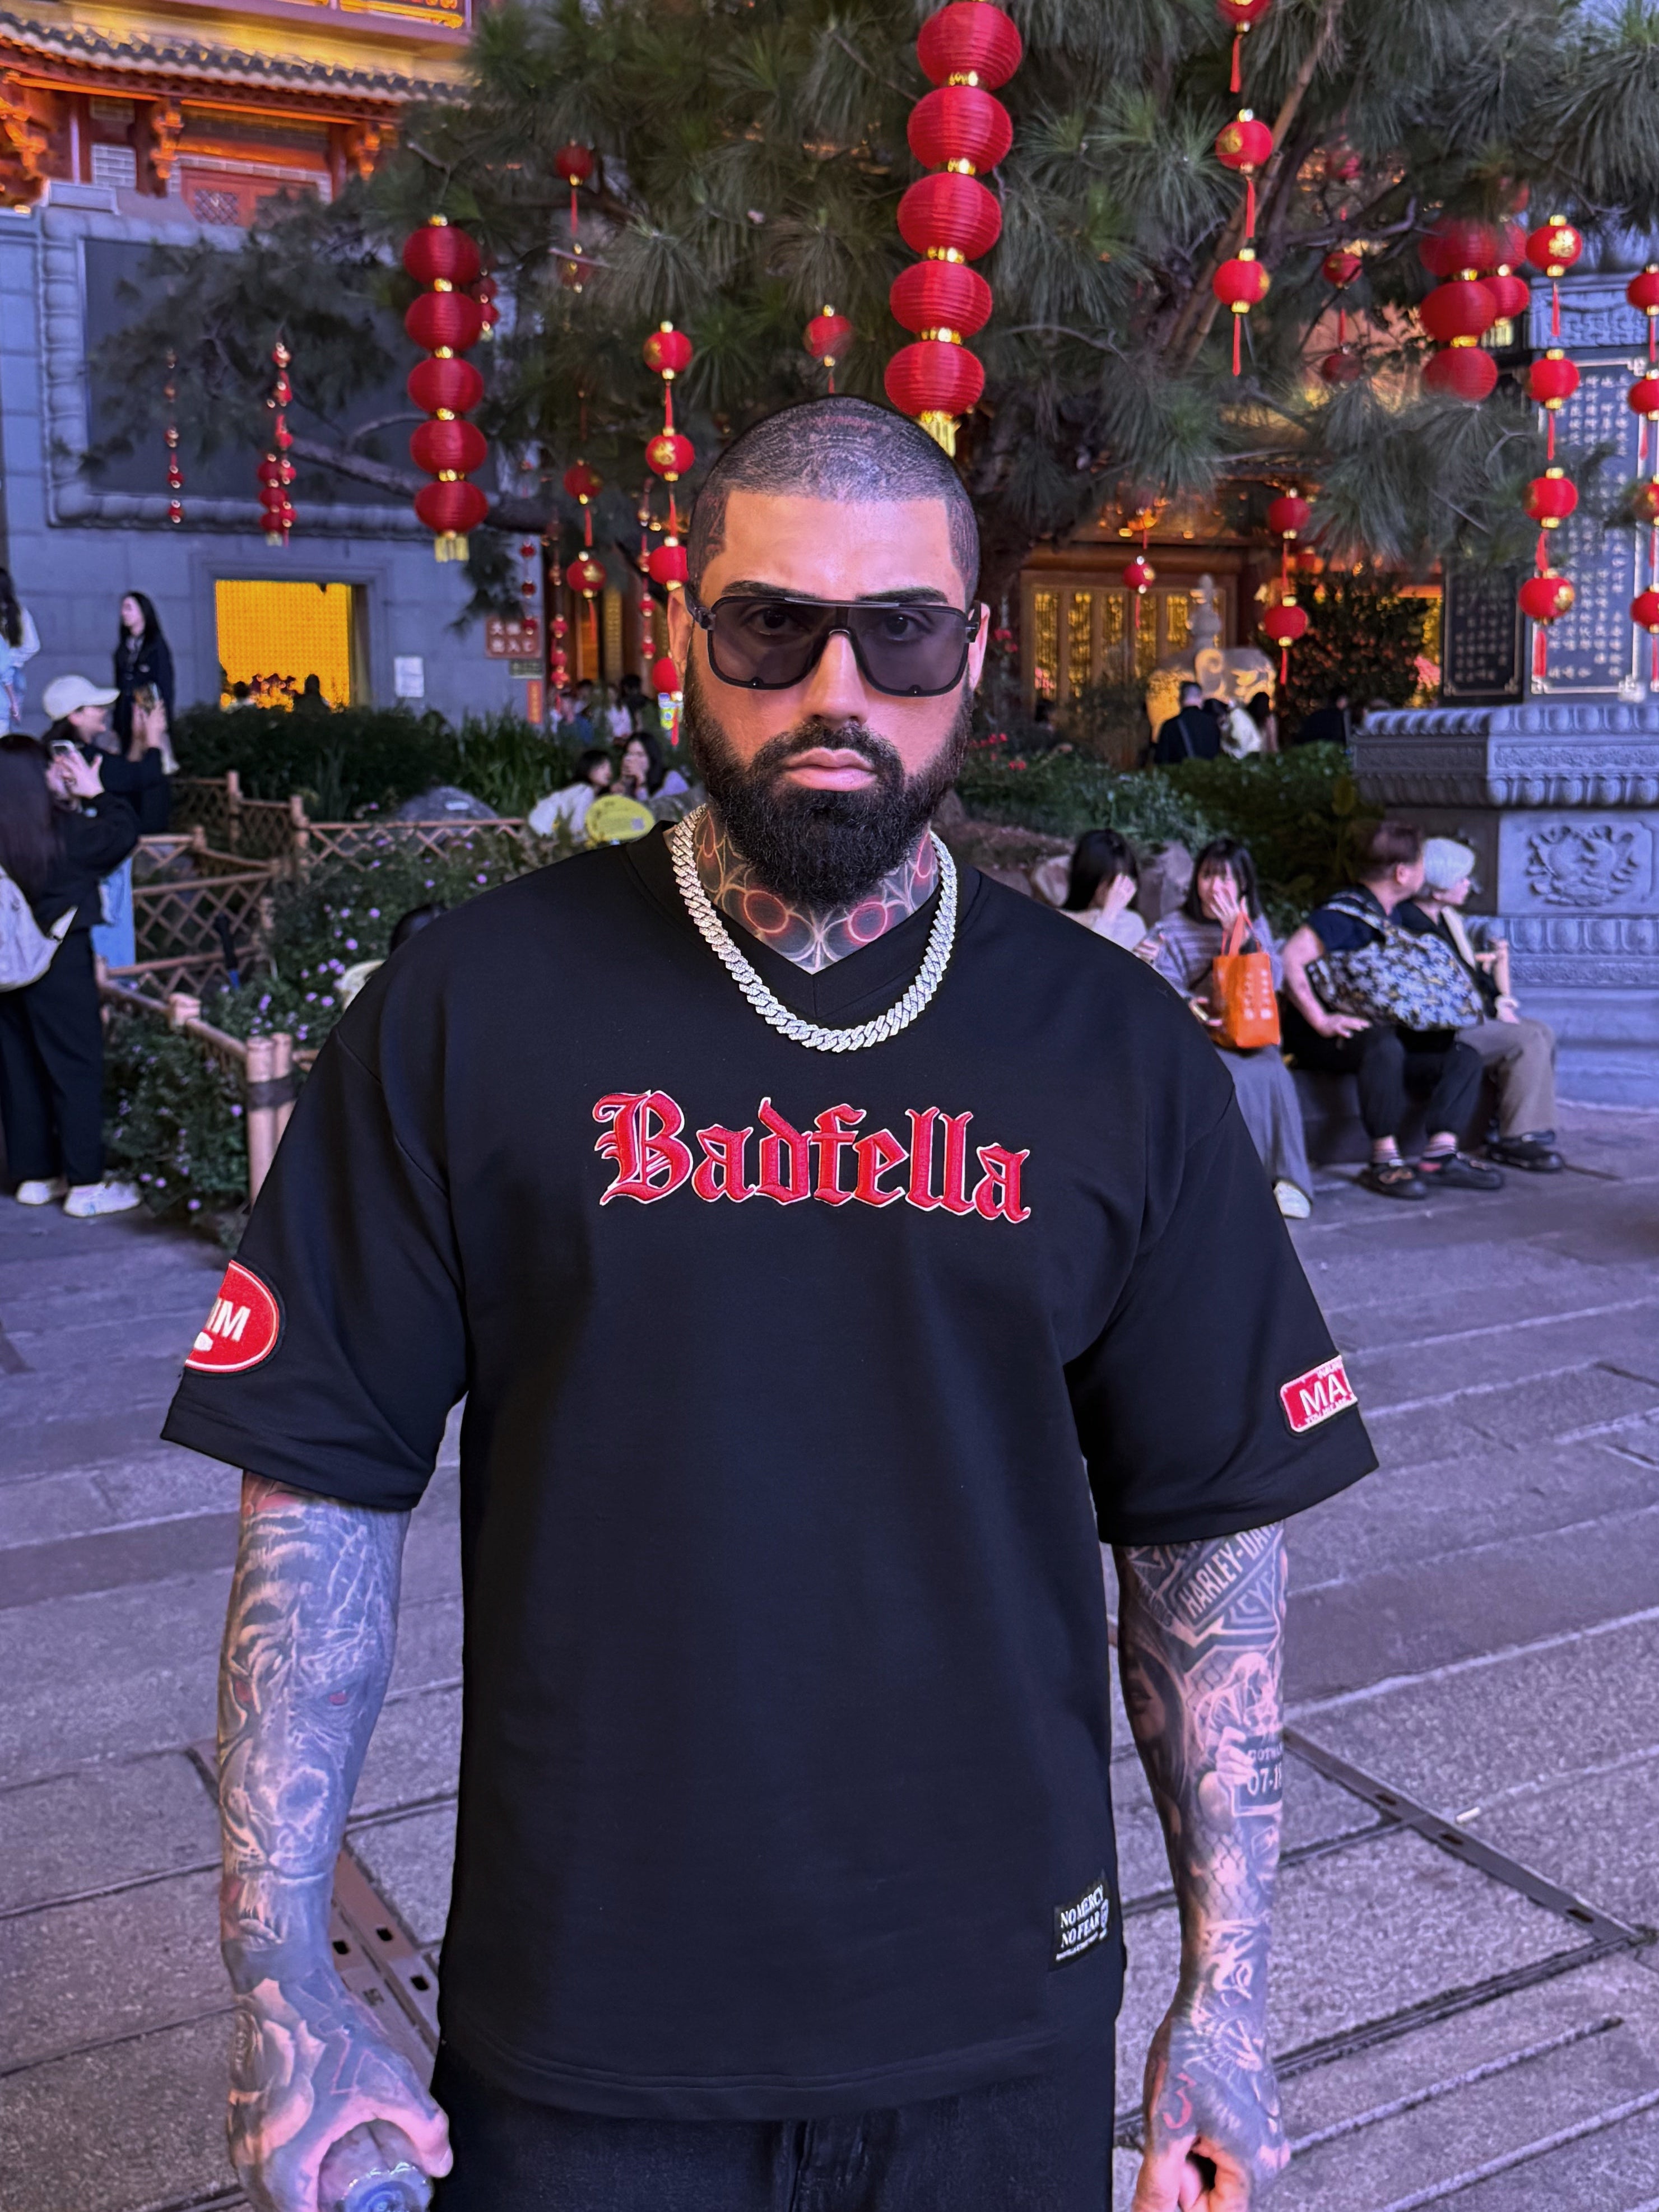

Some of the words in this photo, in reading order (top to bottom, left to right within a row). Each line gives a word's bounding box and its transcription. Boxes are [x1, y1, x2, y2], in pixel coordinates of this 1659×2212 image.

[592, 1090, 1031, 1224] Badfella
[1061, 1908, 1076, 1928] NO
[1061, 1928, 1076, 1949] NO
